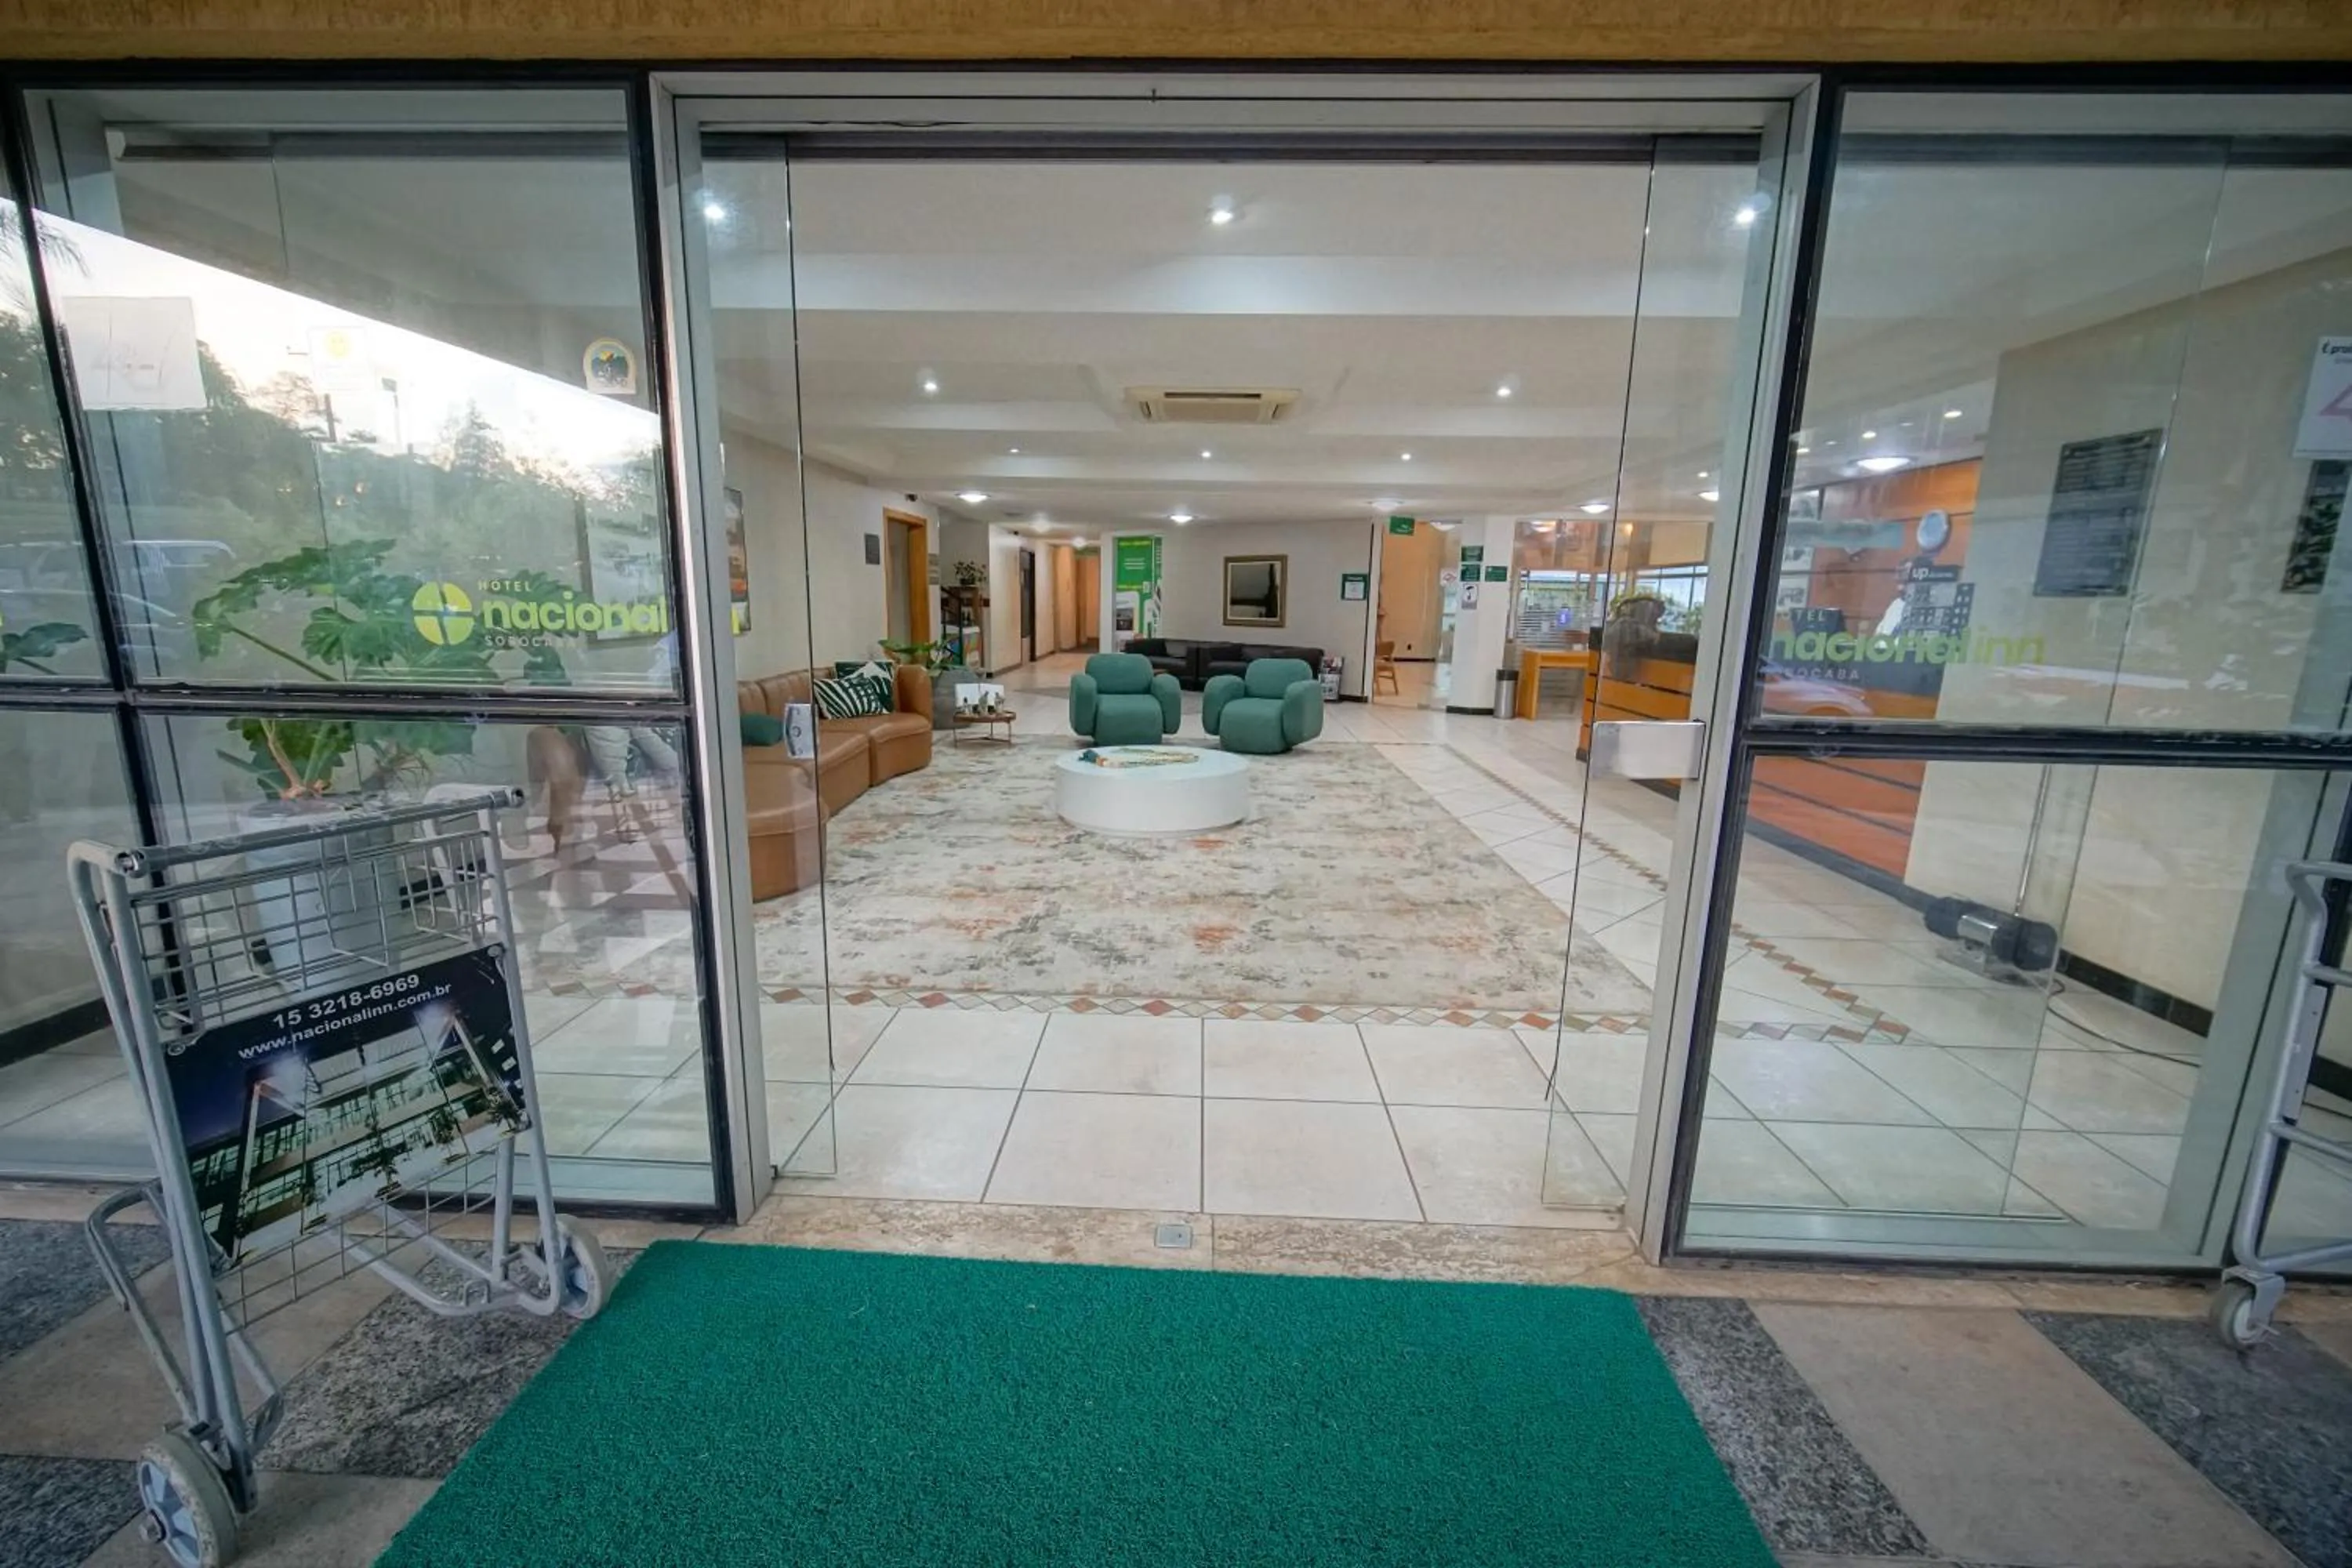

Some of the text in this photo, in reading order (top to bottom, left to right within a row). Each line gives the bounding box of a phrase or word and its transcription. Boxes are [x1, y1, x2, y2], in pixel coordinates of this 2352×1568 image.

[478, 579, 532, 592] HOTEL
[484, 590, 669, 633] nacional
[1773, 608, 1826, 623] OTEL
[484, 635, 579, 648] SOROCA
[273, 975, 419, 1029] 15 3218-6969
[238, 983, 452, 1058] www.nacionalinn.com.br
